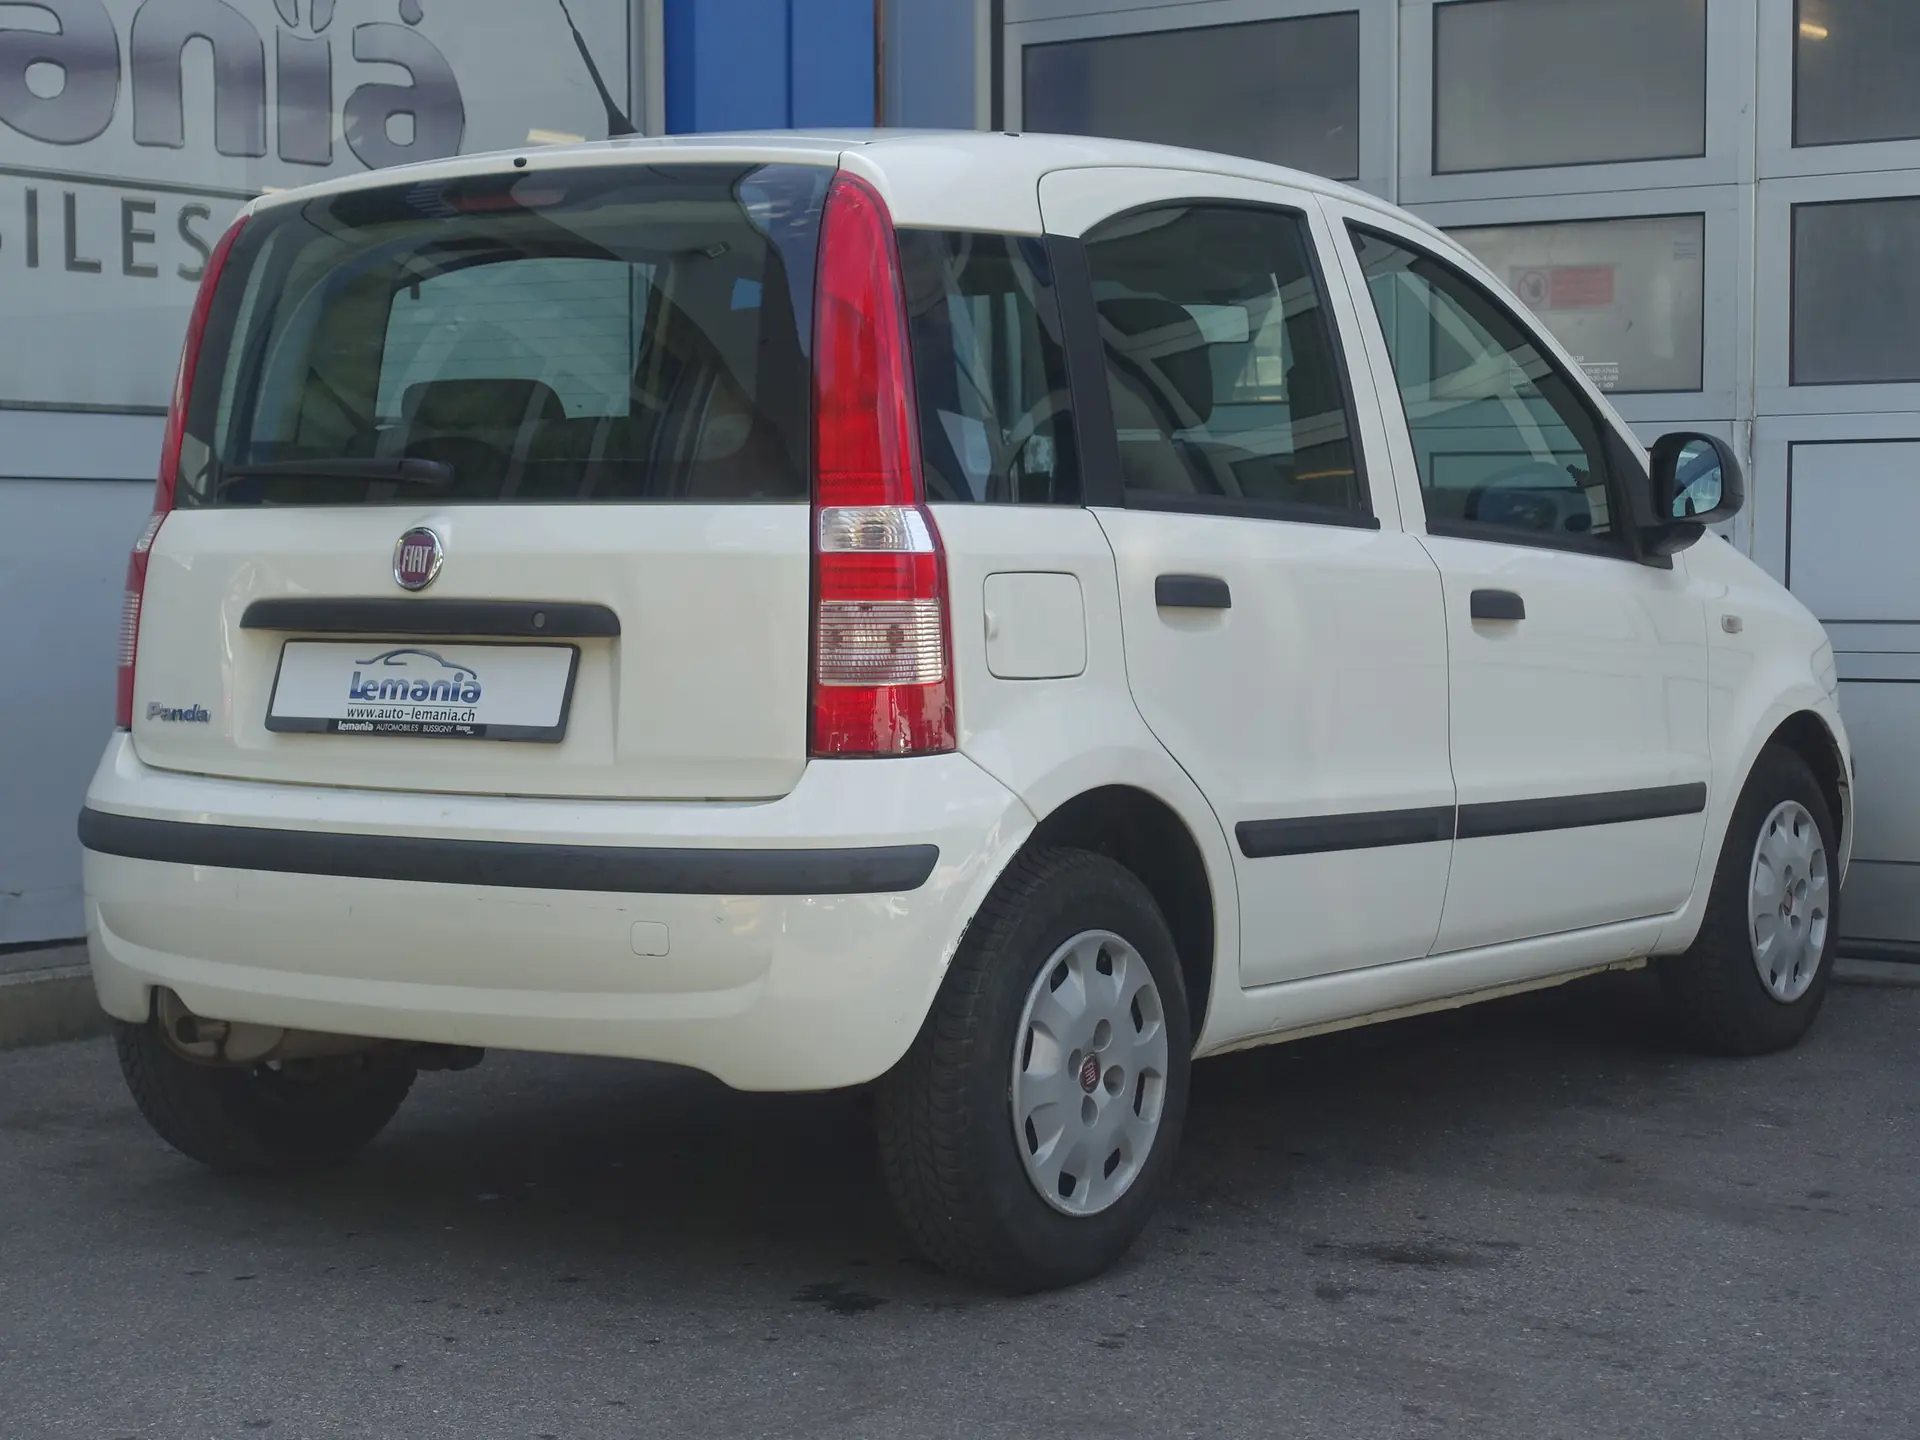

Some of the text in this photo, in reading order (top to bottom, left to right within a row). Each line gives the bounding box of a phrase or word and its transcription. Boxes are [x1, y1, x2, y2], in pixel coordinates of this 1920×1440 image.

[0, 186, 213, 282] ILES
[401, 544, 432, 573] FIAT
[348, 671, 482, 704] Lemania
[146, 701, 211, 723] Panda
[347, 707, 476, 722] www.auto-lemania.ch
[375, 723, 419, 732] AUTOMOBILES
[422, 724, 454, 733] BUSSIGNY
